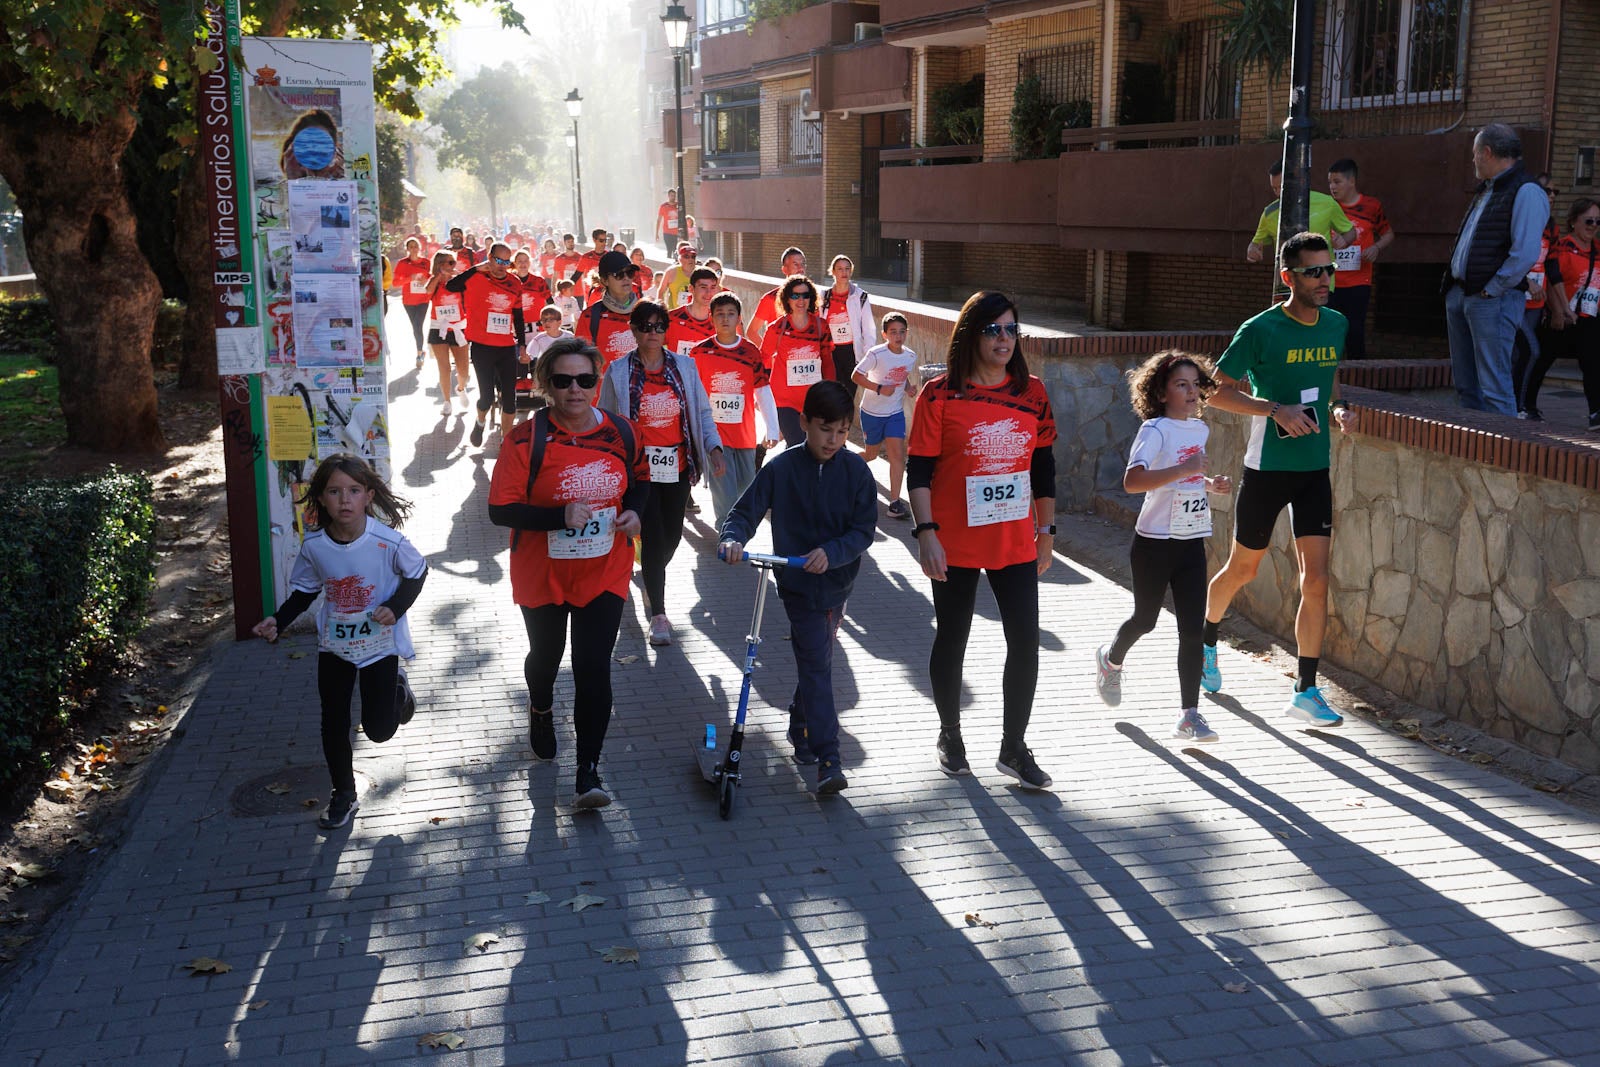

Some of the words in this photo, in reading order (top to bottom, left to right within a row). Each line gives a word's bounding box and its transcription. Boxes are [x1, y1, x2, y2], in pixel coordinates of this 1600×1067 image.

[315, 77, 367, 87] Ayuntamiento
[232, 85, 241, 106] Ruta
[216, 274, 251, 283] MPS
[836, 327, 847, 335] 42
[1286, 346, 1337, 364] BIKILA
[792, 364, 816, 374] 1310
[715, 400, 740, 411] 1049
[971, 433, 1027, 446] carrera
[561, 475, 620, 490] carrera
[983, 484, 1015, 502] 952
[1182, 497, 1208, 513] 122
[335, 621, 372, 639] 574
